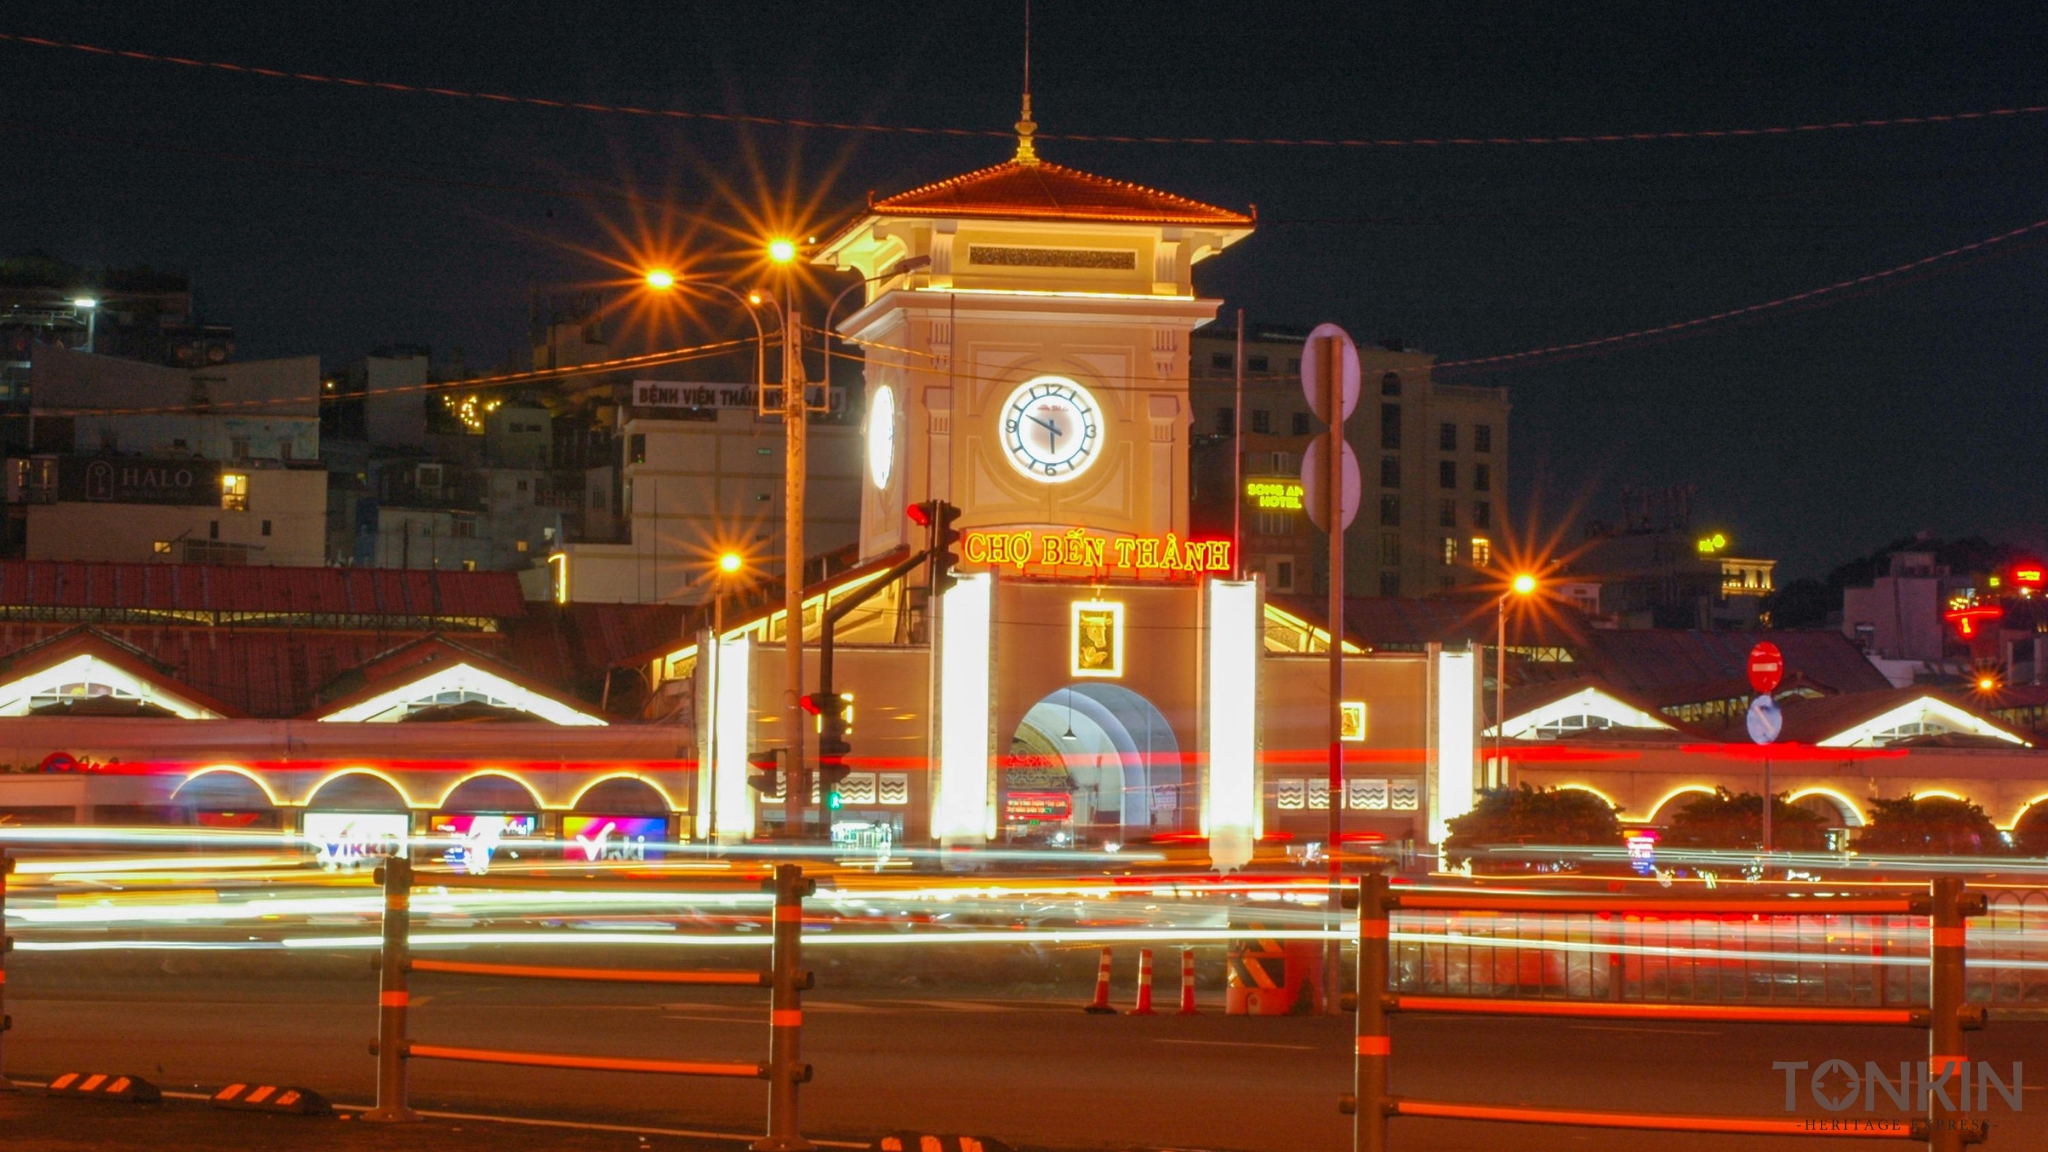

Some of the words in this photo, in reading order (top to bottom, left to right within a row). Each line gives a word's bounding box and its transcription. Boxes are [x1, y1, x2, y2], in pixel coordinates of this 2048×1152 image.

[639, 384, 679, 405] BỆNH
[683, 386, 716, 407] VIỆN
[1043, 384, 1064, 396] 12
[1006, 420, 1017, 433] 9
[1086, 425, 1097, 439] 3
[1045, 464, 1057, 476] 6
[122, 467, 193, 488] HALO
[1248, 484, 1285, 496] SONG
[1260, 496, 1302, 508] HOTEL
[965, 531, 1032, 568] CHỢ
[1042, 528, 1106, 567] BẾN
[1115, 533, 1231, 572] THÀNH
